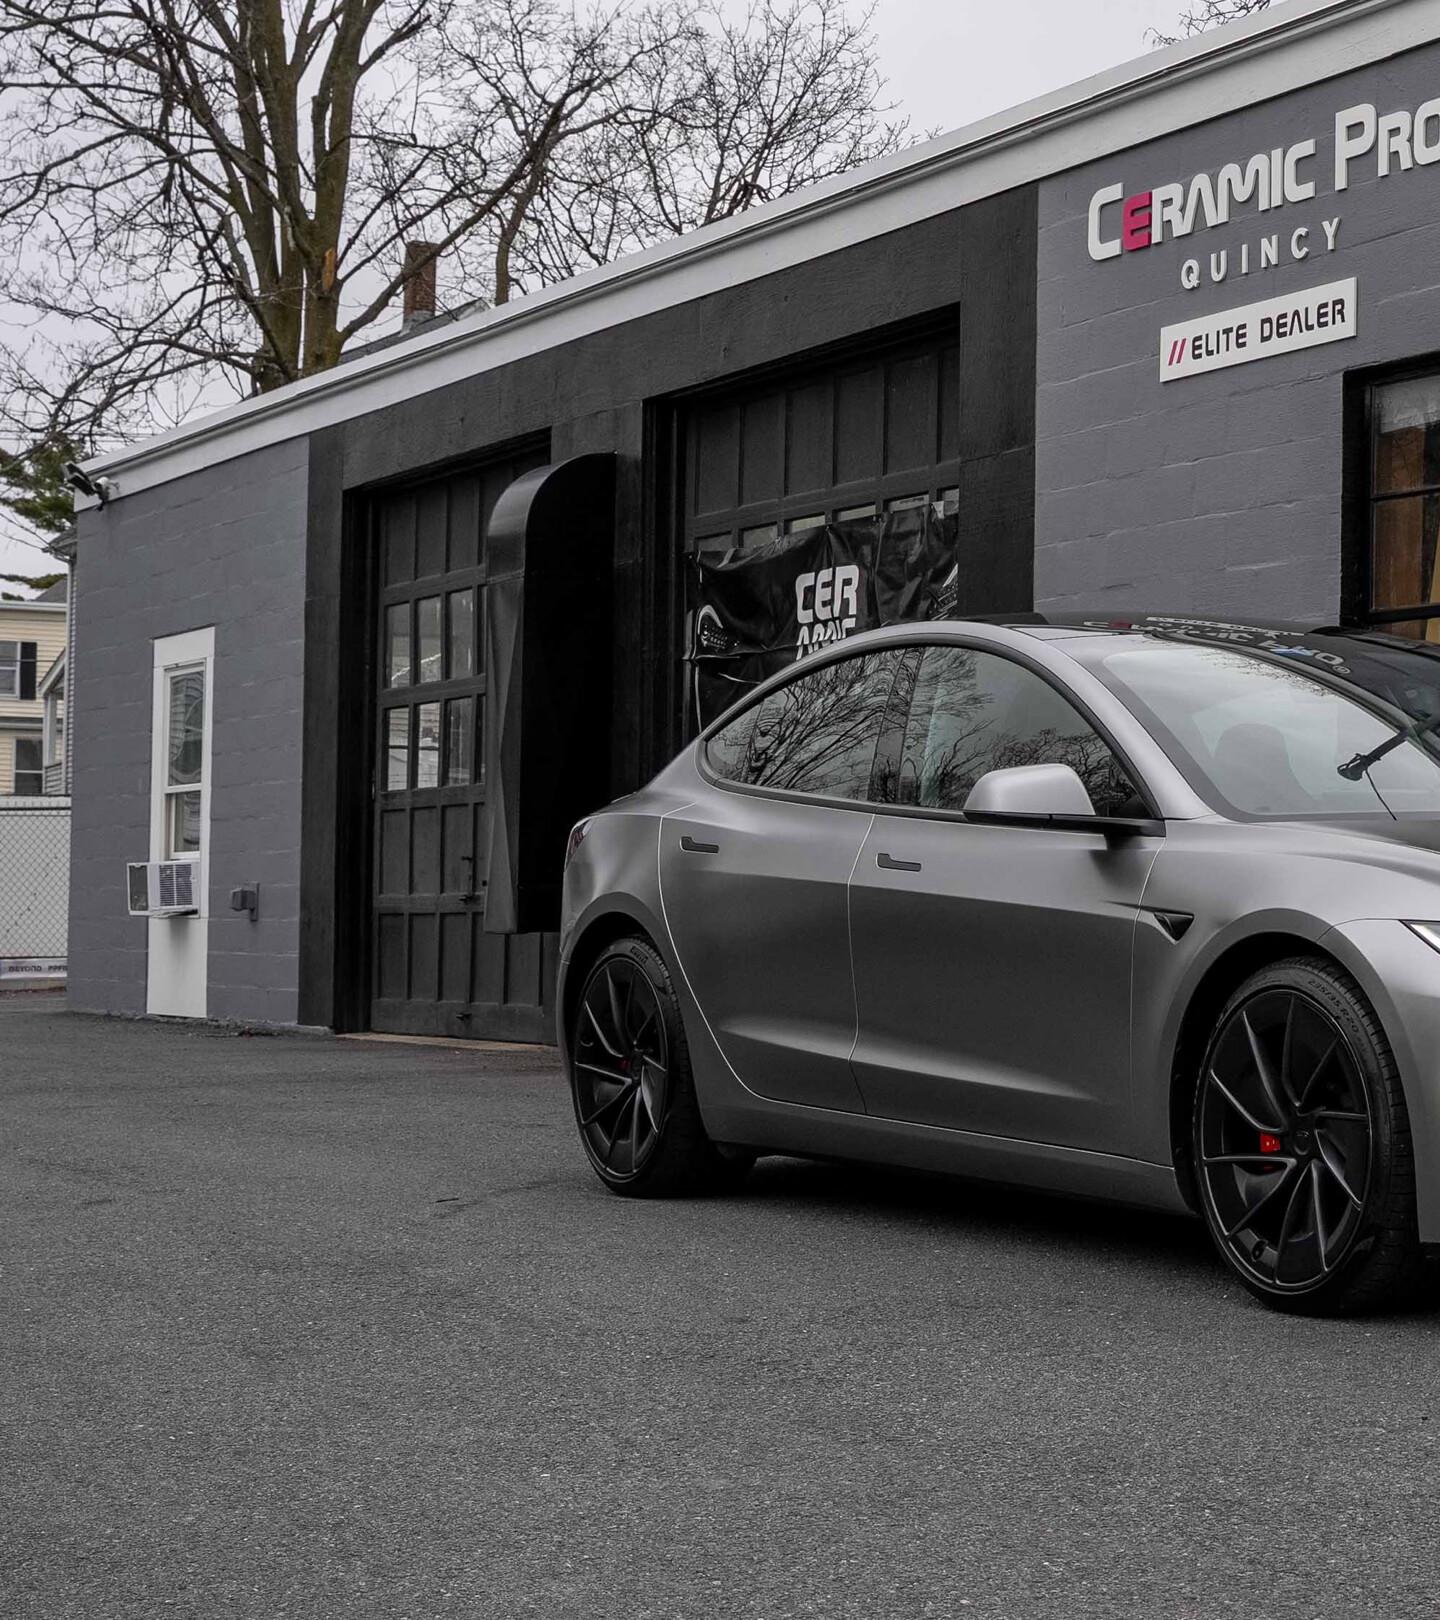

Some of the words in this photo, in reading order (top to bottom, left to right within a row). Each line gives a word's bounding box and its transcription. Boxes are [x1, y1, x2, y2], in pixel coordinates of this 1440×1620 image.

[1087, 138, 1316, 261] CERAMIC
[1180, 216, 1342, 290] QUINCY
[1260, 298, 1346, 344] DEALER
[795, 564, 859, 624] CER
